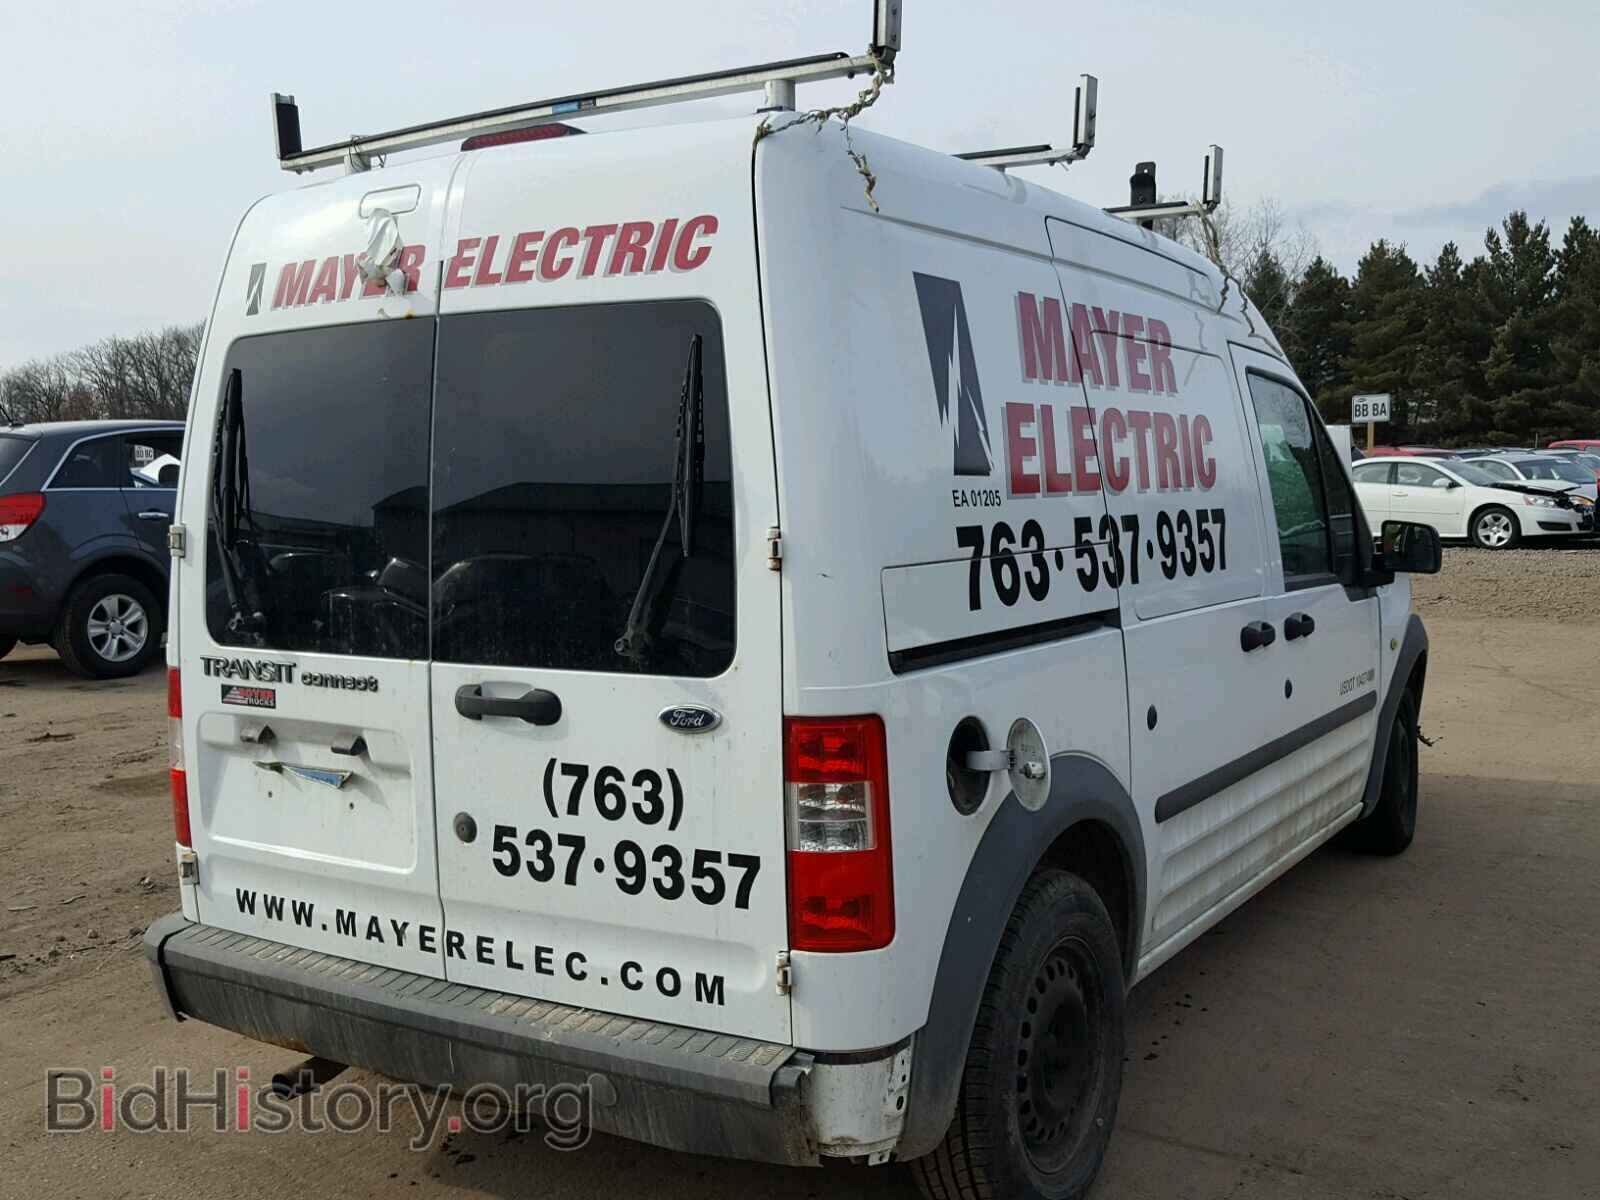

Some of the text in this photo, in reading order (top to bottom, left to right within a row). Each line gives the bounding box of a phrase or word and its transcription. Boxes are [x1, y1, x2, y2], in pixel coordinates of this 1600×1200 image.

[443, 213, 720, 289] ELECTRIC
[1014, 290, 1179, 397] MAYER
[1354, 402, 1388, 417] BB BA
[1001, 401, 1218, 500] ELECTRIC
[952, 490, 1002, 507] EA 01205
[200, 655, 297, 684] TRANSIT
[669, 708, 706, 728] Ford
[543, 757, 684, 832] (763)
[235, 887, 727, 1007] WWW.MAYERELEC.COM
